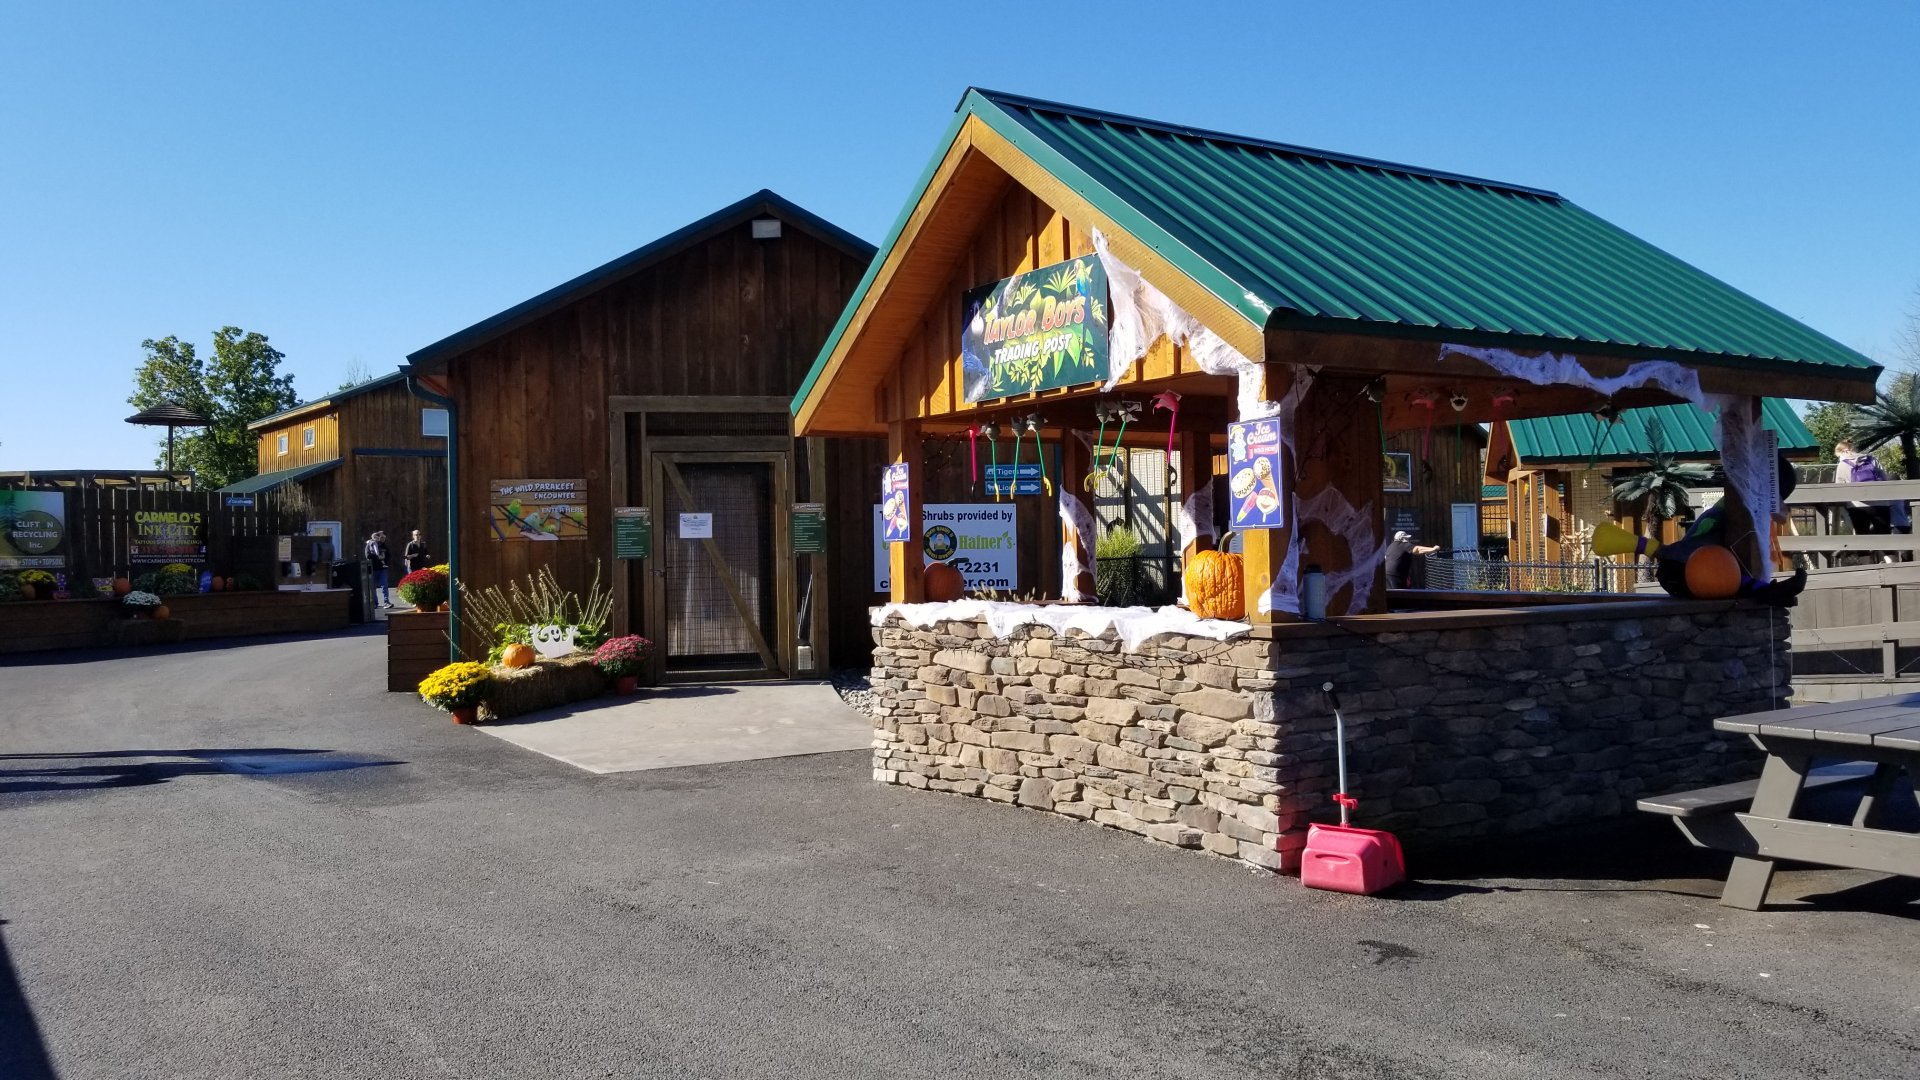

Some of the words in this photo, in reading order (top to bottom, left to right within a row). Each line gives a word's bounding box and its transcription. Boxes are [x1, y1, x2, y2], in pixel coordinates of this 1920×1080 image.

[984, 309, 1037, 344] TAYLOR
[1041, 296, 1085, 331] BOYS
[994, 340, 1039, 364] TRADING
[1043, 334, 1073, 354] POST
[1247, 432, 1277, 445] Cream
[500, 486, 514, 496] THE
[515, 483, 533, 494] WILD
[535, 482, 575, 491] PARAKEET
[534, 492, 576, 500] ENCOUNTER
[134, 511, 201, 523] CARMELO'S
[923, 510, 954, 520] Shrubs
[958, 510, 998, 522] provided
[1001, 510, 1013, 522] by
[959, 531, 1013, 549] Hainer's
